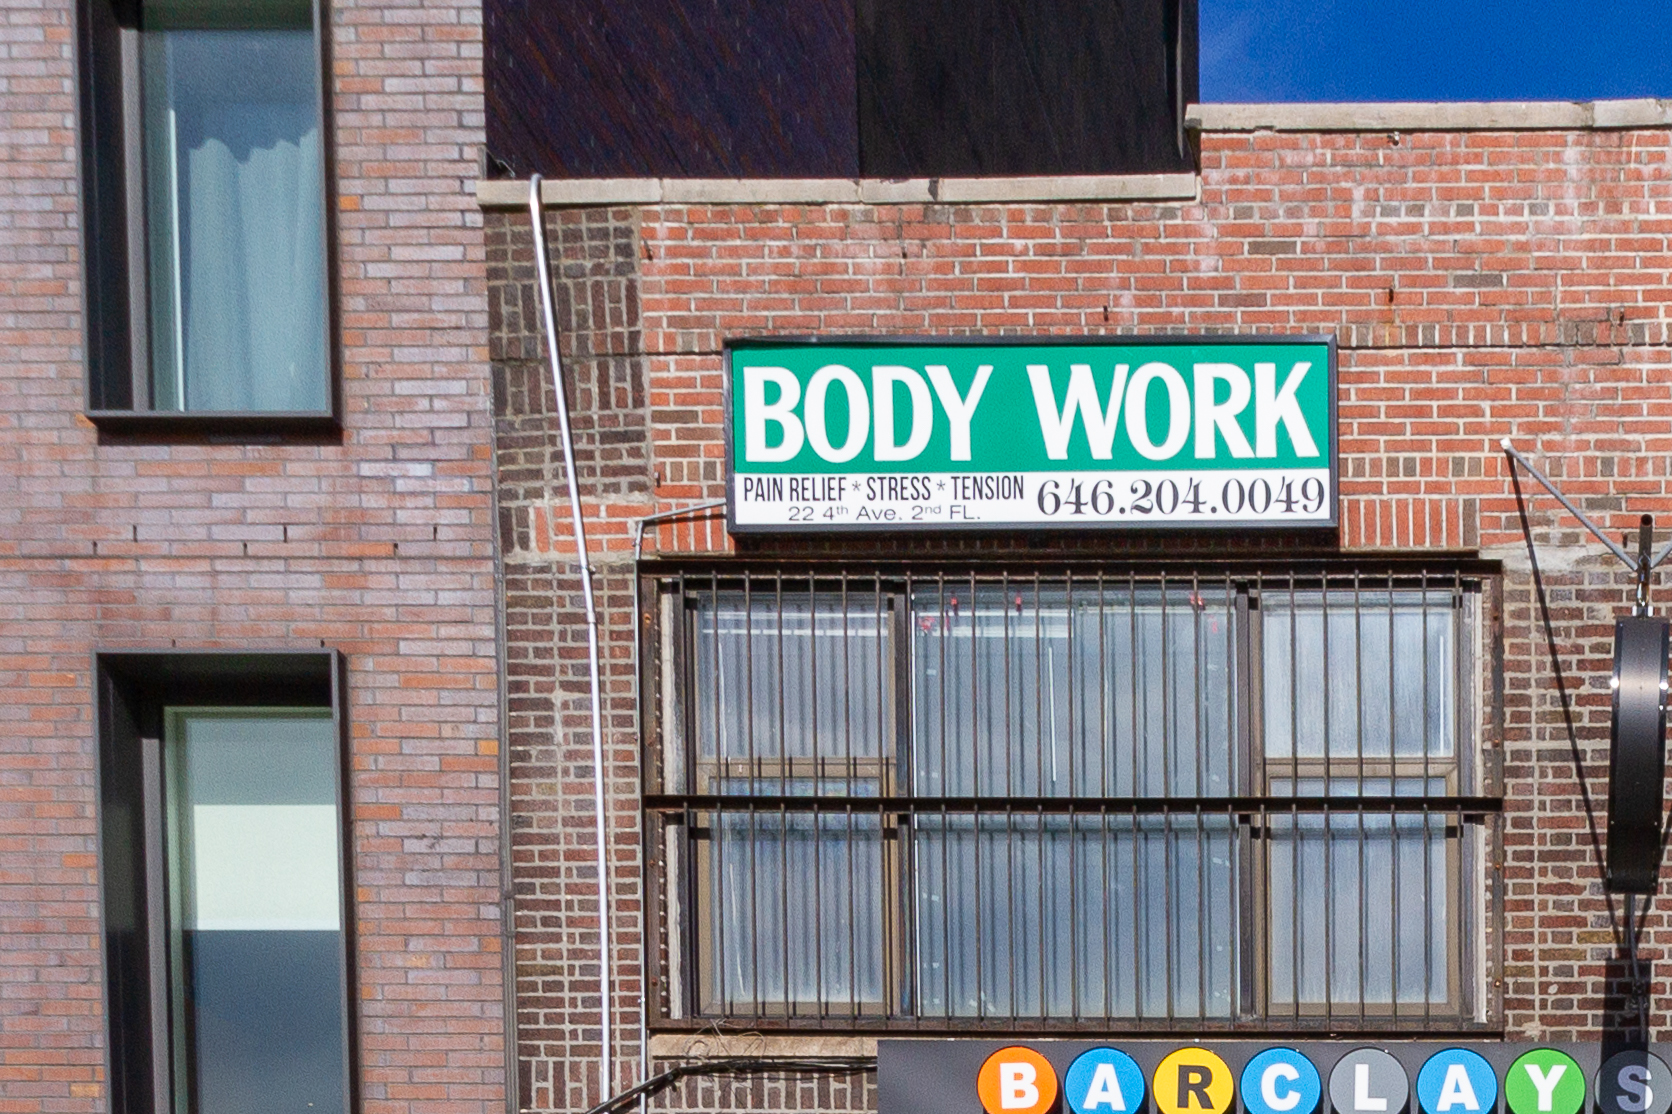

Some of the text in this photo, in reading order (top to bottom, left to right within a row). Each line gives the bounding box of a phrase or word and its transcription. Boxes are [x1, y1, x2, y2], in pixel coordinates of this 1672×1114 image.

[743, 361, 1320, 464] BODY WORK
[744, 475, 1025, 502] PAIN RELIEF STRESS TENSION
[1036, 476, 1326, 517] 646.204.0049
[788, 504, 981, 522] 22 4th Ave. 2nd FL.
[998, 1060, 1654, 1113] BARCLAYS
